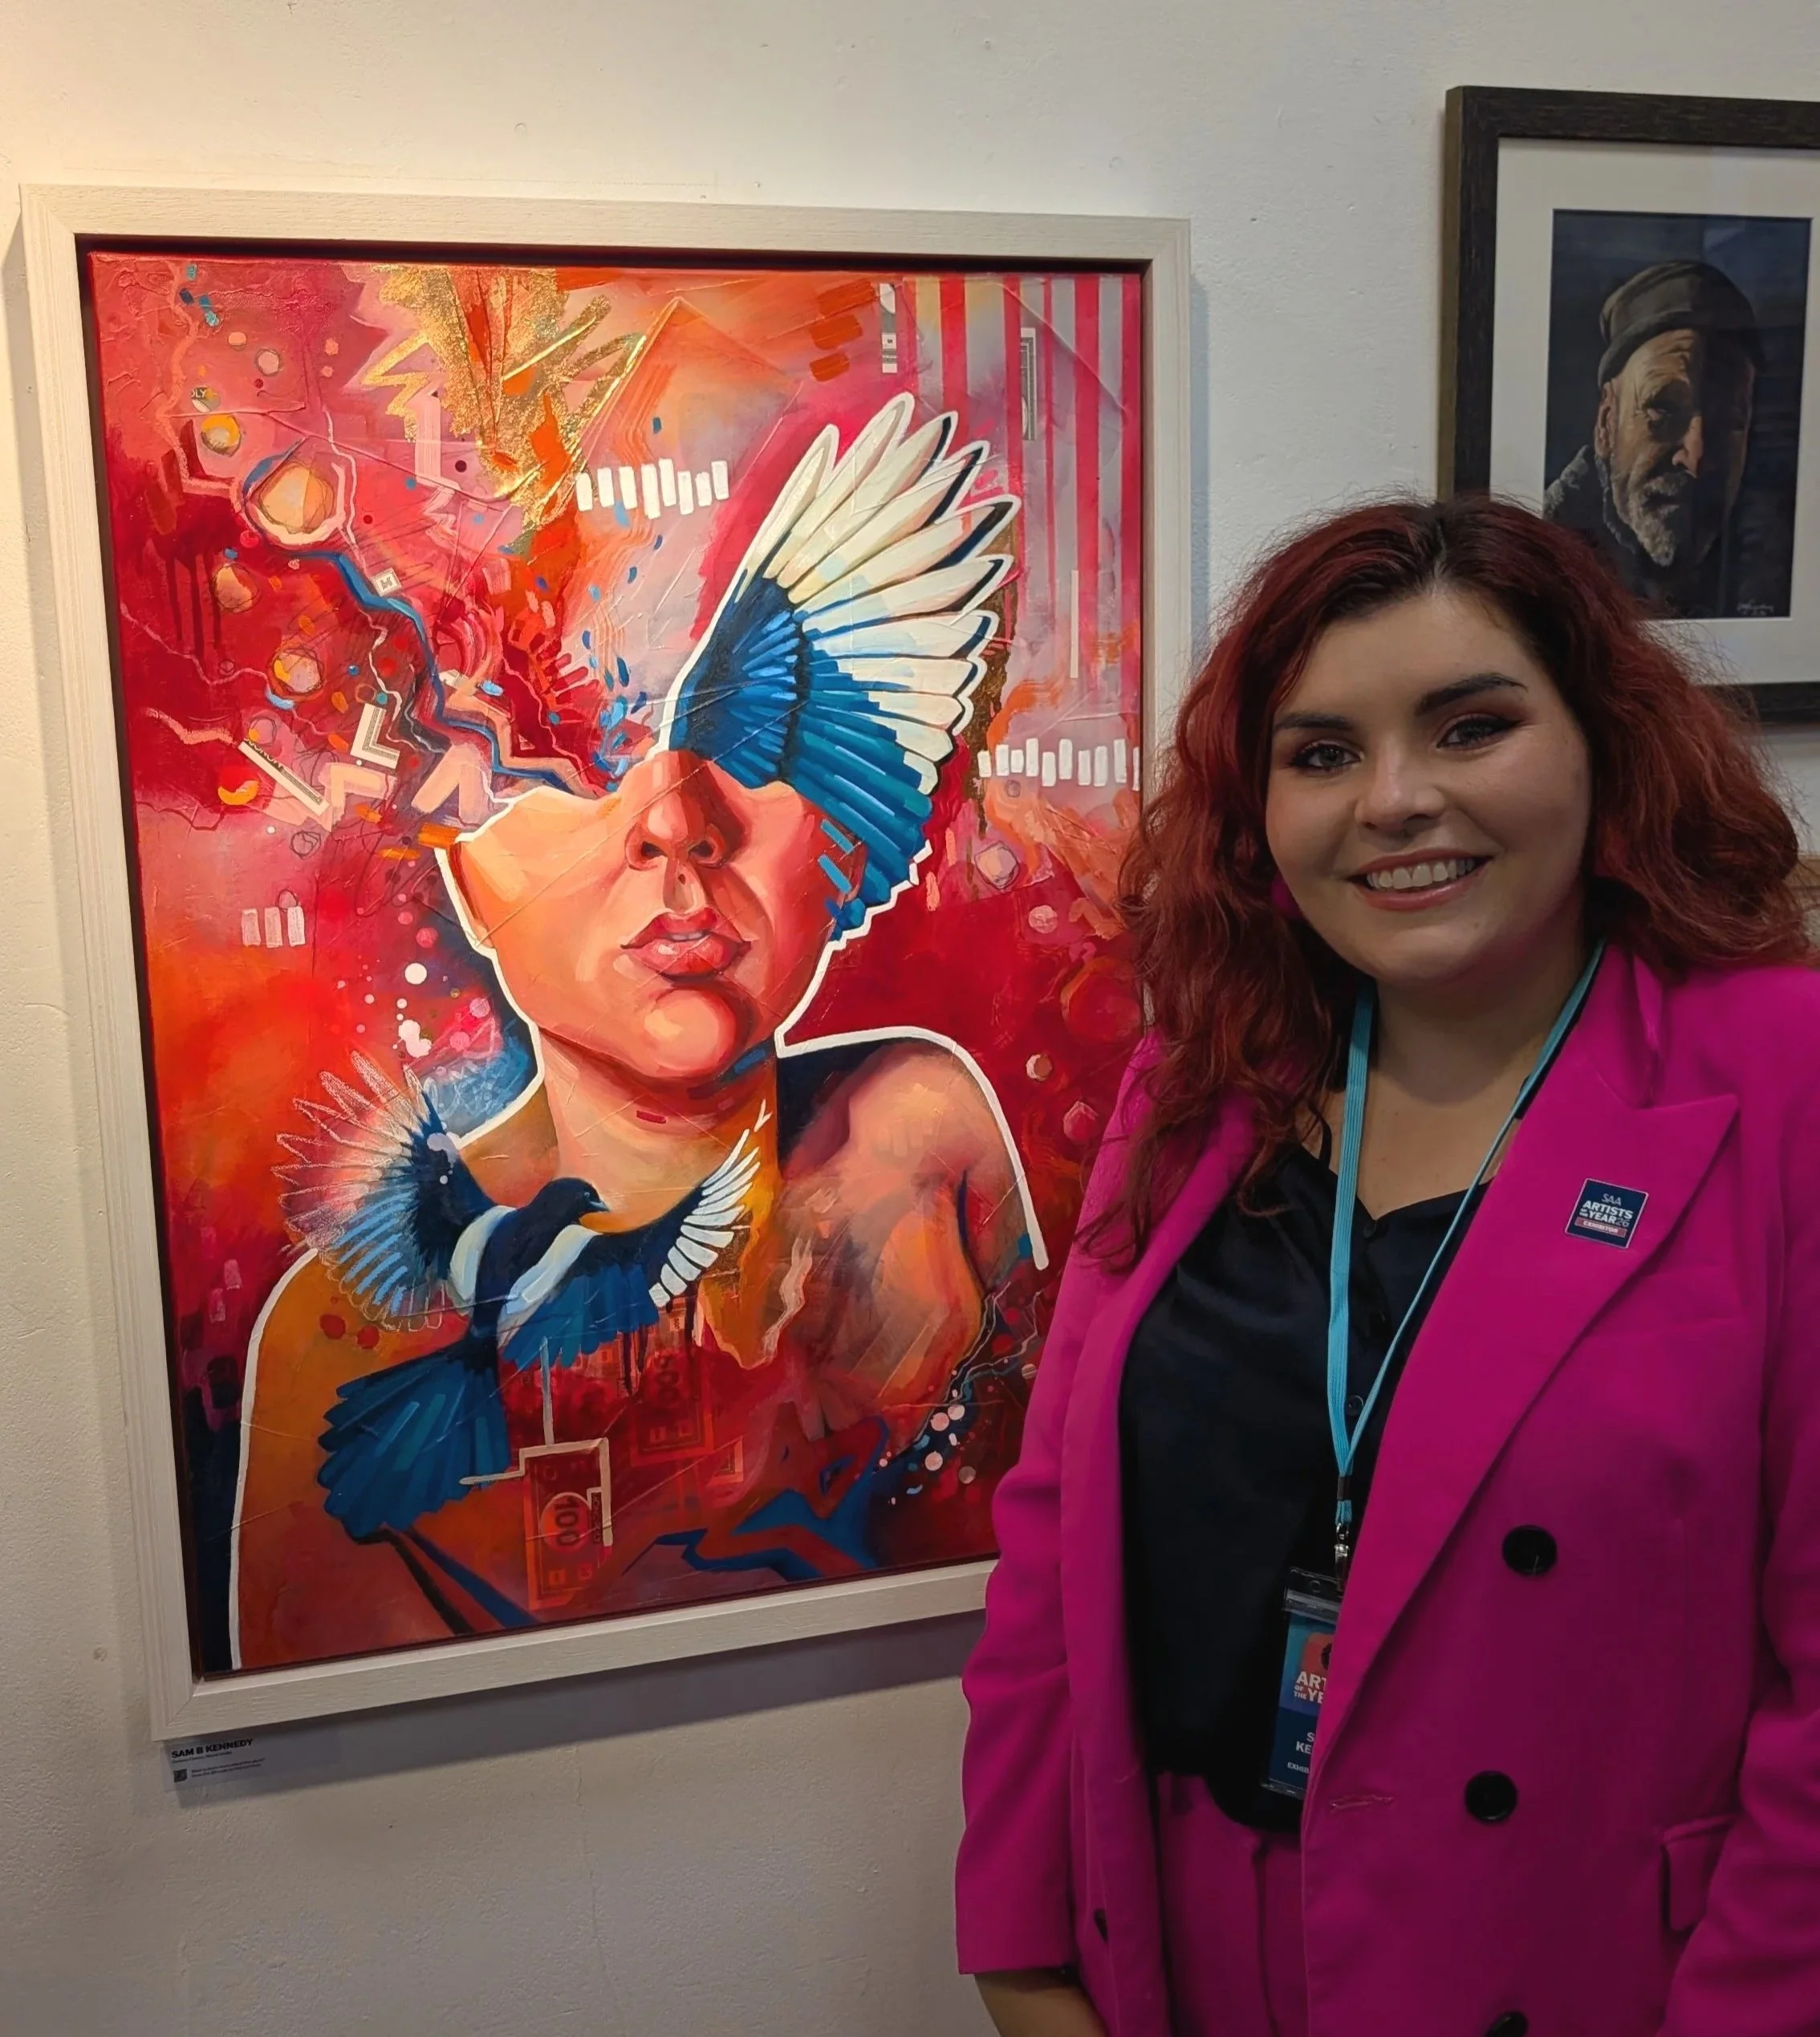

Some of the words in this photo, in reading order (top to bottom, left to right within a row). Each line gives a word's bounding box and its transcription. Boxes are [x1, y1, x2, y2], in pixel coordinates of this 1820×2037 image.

[1601, 1193, 1622, 1206] SAA
[1582, 1200, 1634, 1220] ARTISTS
[555, 1499, 578, 1546] 100
[171, 1748, 194, 1758] SAM
[196, 1746, 204, 1754] B
[205, 1738, 254, 1753] KENNEDY
